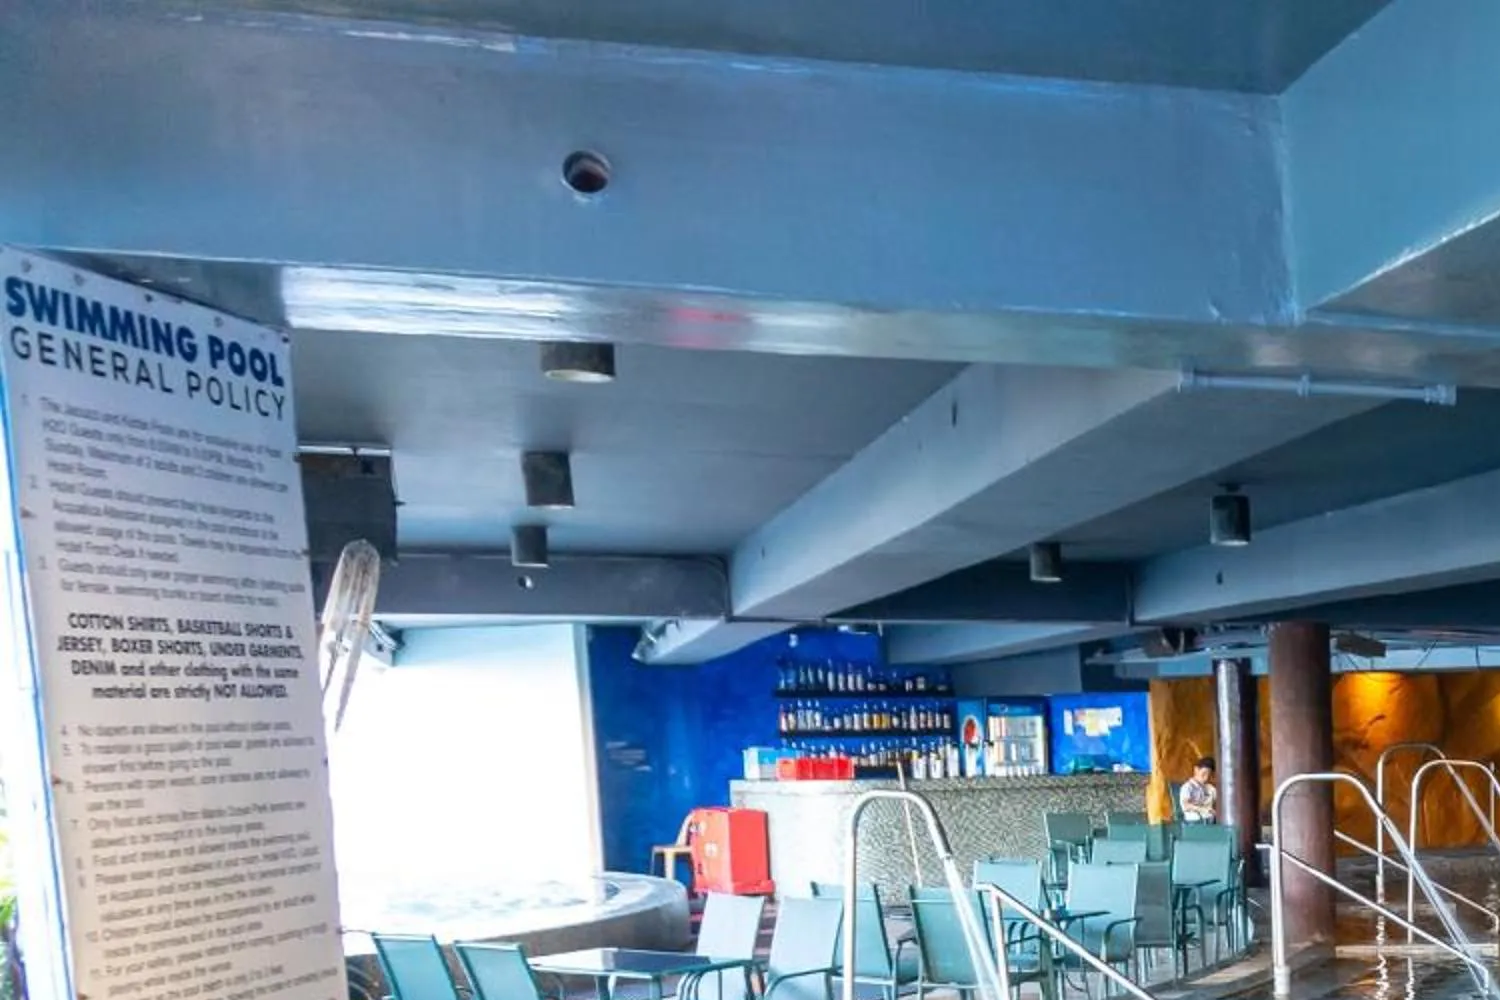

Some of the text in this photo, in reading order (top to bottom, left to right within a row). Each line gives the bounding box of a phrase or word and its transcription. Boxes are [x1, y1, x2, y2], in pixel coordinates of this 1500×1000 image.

[5, 276, 285, 387] SWIMMING POOL
[10, 326, 285, 420] GENERAL POLICY
[68, 612, 123, 630] COTTON
[177, 619, 242, 636] BASKETBALL
[245, 623, 282, 639] SHORTS
[111, 638, 152, 653] BOXER
[209, 641, 246, 657] UNDER
[71, 659, 117, 676] DENIM
[120, 661, 145, 676] and
[149, 661, 181, 677] other
[184, 662, 228, 682] clothing
[255, 664, 271, 678] the
[91, 682, 146, 699] material
[150, 687, 171, 699] are
[213, 684, 237, 698] NOT
